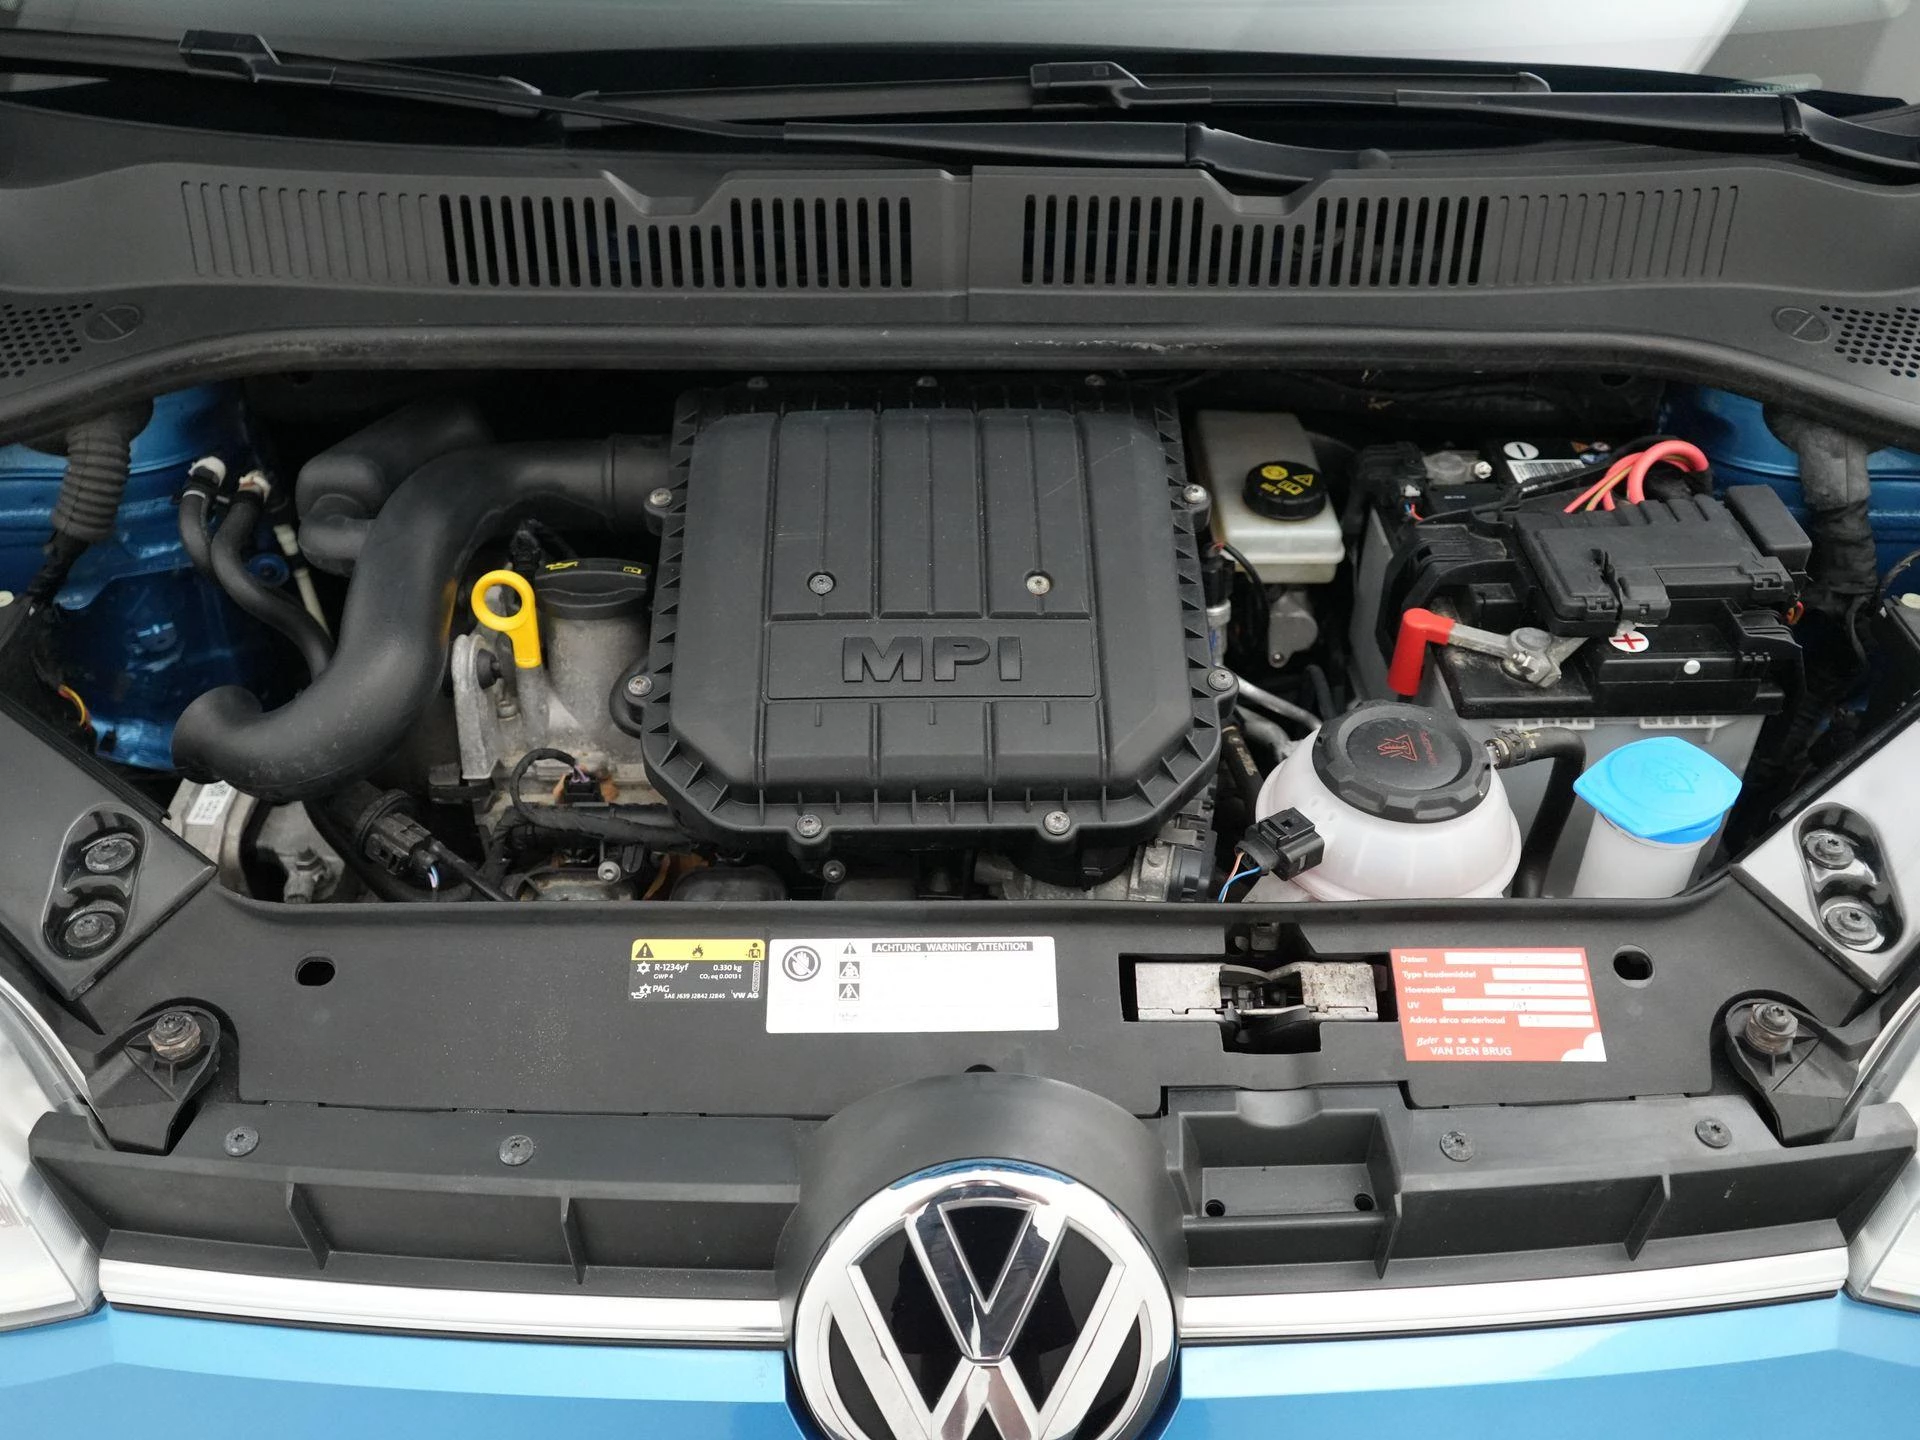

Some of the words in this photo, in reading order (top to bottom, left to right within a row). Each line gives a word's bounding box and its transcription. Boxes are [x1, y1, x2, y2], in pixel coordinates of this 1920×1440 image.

[842, 635, 1023, 683] MPI
[875, 943, 922, 952] ACHTUNG
[925, 942, 972, 952] WARNING
[976, 942, 1028, 951] ATTENTION
[654, 963, 689, 973] R-1234yf
[713, 964, 732, 972] 0.330
[733, 963, 742, 973] kg
[1403, 970, 1422, 979] Type
[652, 985, 670, 993] PAG
[1407, 1001, 1420, 1009] UV
[1431, 1047, 1453, 1056] VAN
[1457, 1047, 1479, 1056] DEN
[1483, 1047, 1512, 1056] BRUG
